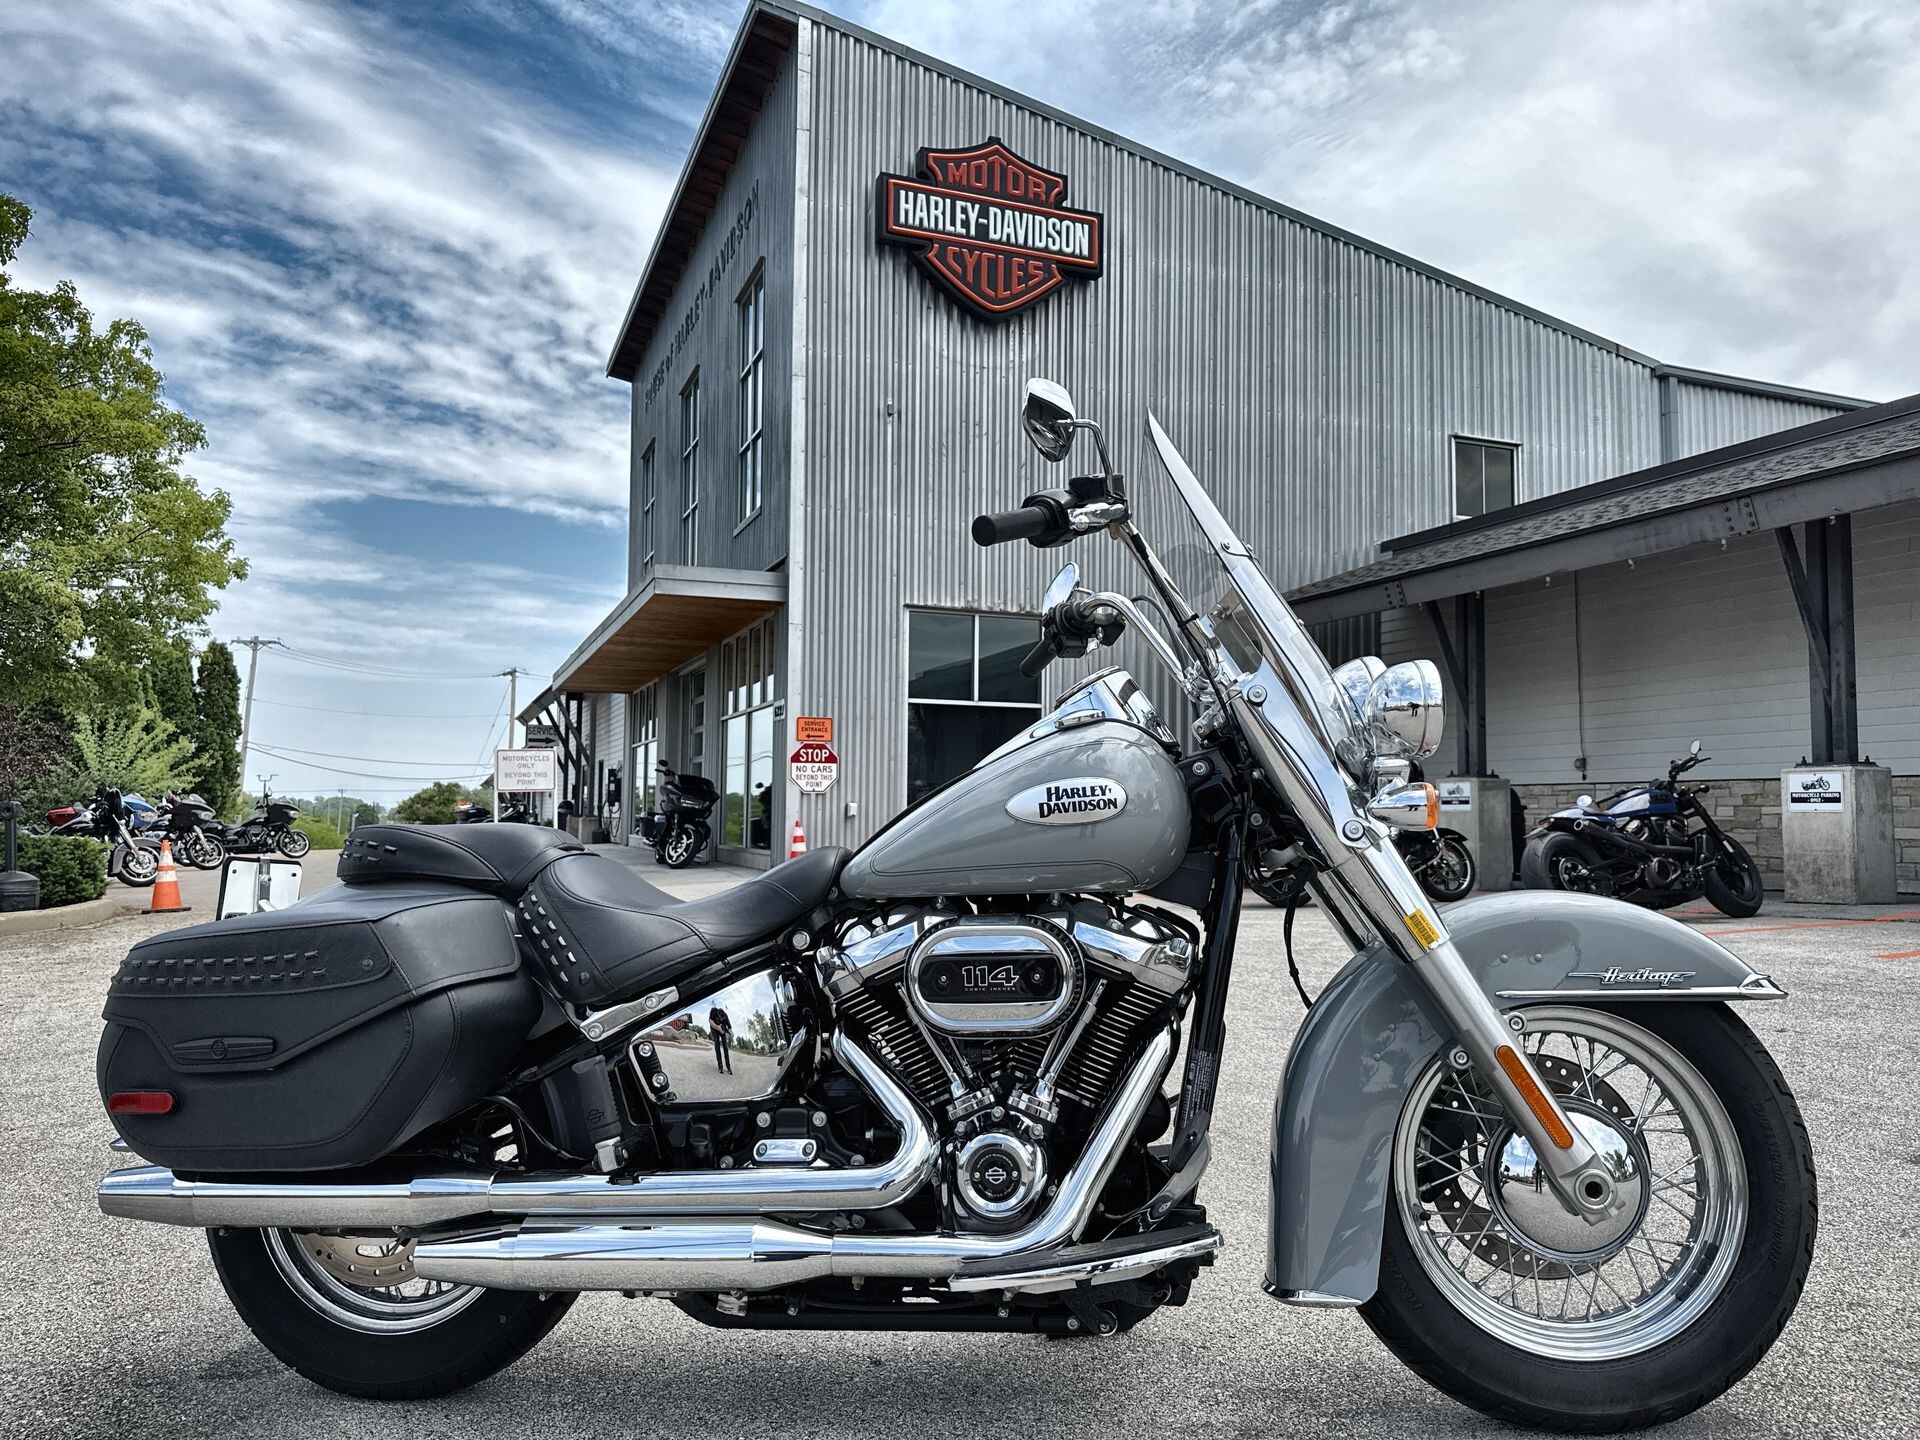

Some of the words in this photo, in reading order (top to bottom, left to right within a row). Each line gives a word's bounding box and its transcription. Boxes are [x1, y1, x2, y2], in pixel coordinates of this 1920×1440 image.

[947, 155, 1046, 203] MOTOR
[899, 189, 1089, 258] HARLEY-DAVIDSON
[947, 246, 1044, 299] CYCLES
[800, 749, 829, 762] STOP
[796, 765, 808, 773] NO
[811, 765, 833, 773] CARS
[1039, 798, 1118, 818] DAVIDSON
[962, 965, 1020, 987] 114
[1601, 966, 1685, 987] Heritage
